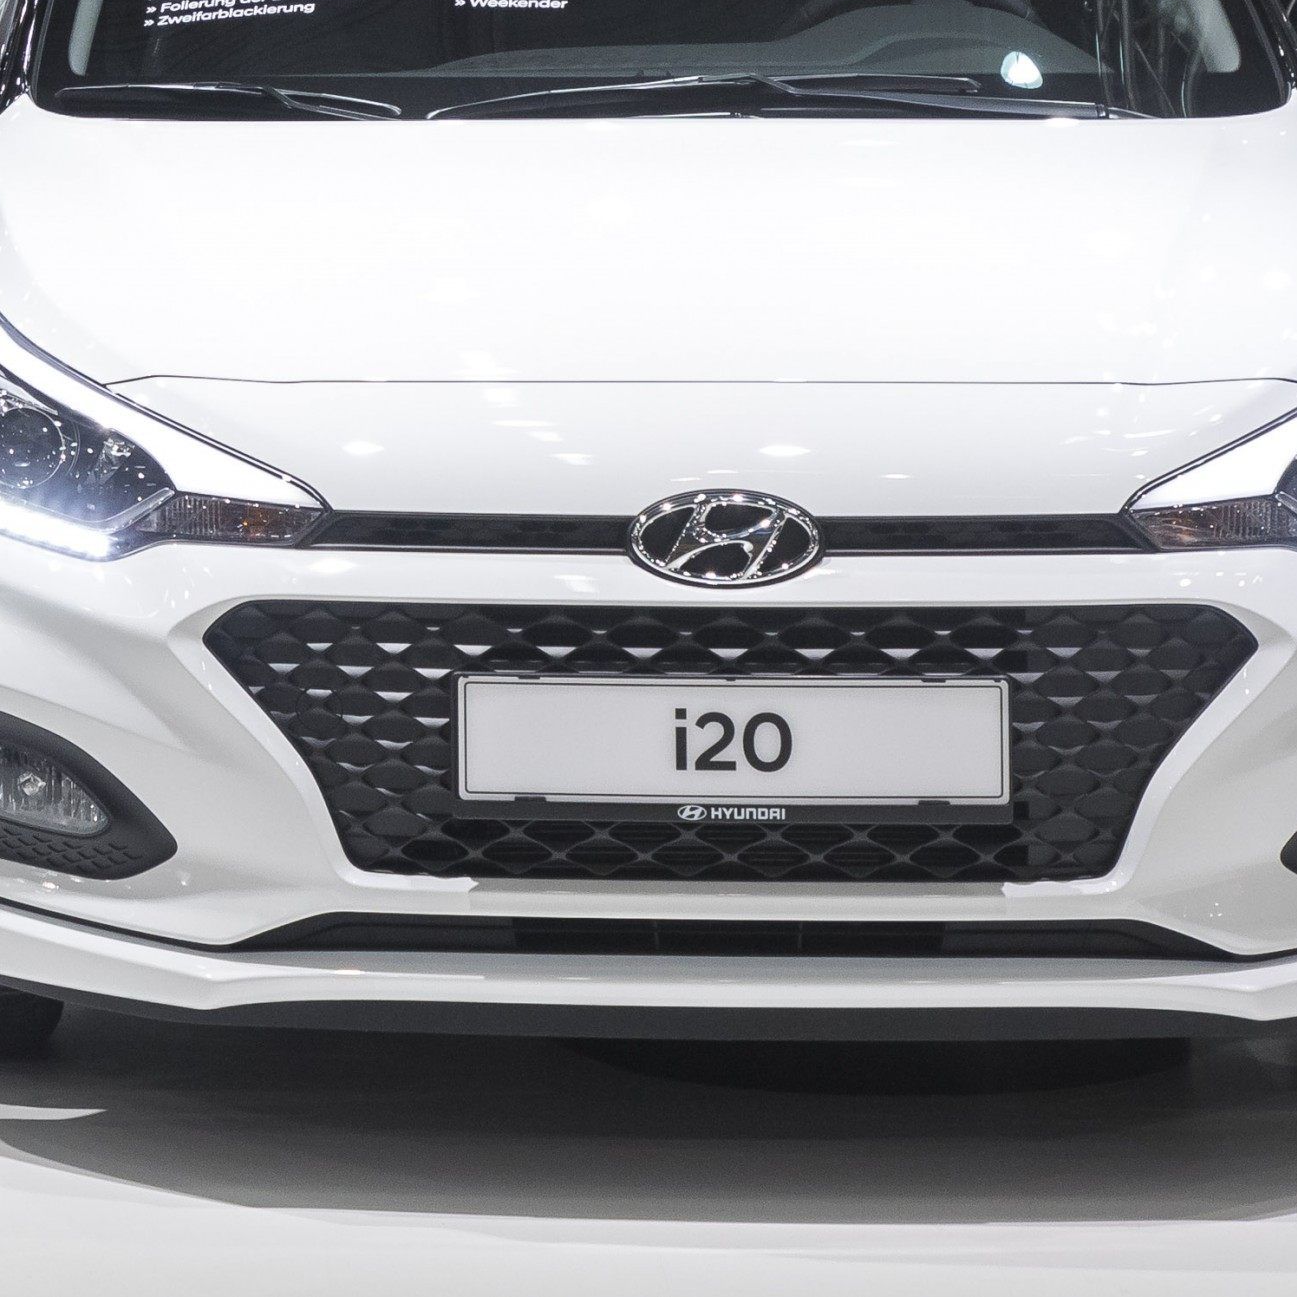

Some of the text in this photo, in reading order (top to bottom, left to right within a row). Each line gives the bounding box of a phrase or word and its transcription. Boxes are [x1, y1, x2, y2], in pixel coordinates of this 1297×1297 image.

[156, 2, 316, 27] Zweifarblackierung
[674, 707, 793, 773] i20
[710, 806, 786, 821] HYUNDAI
